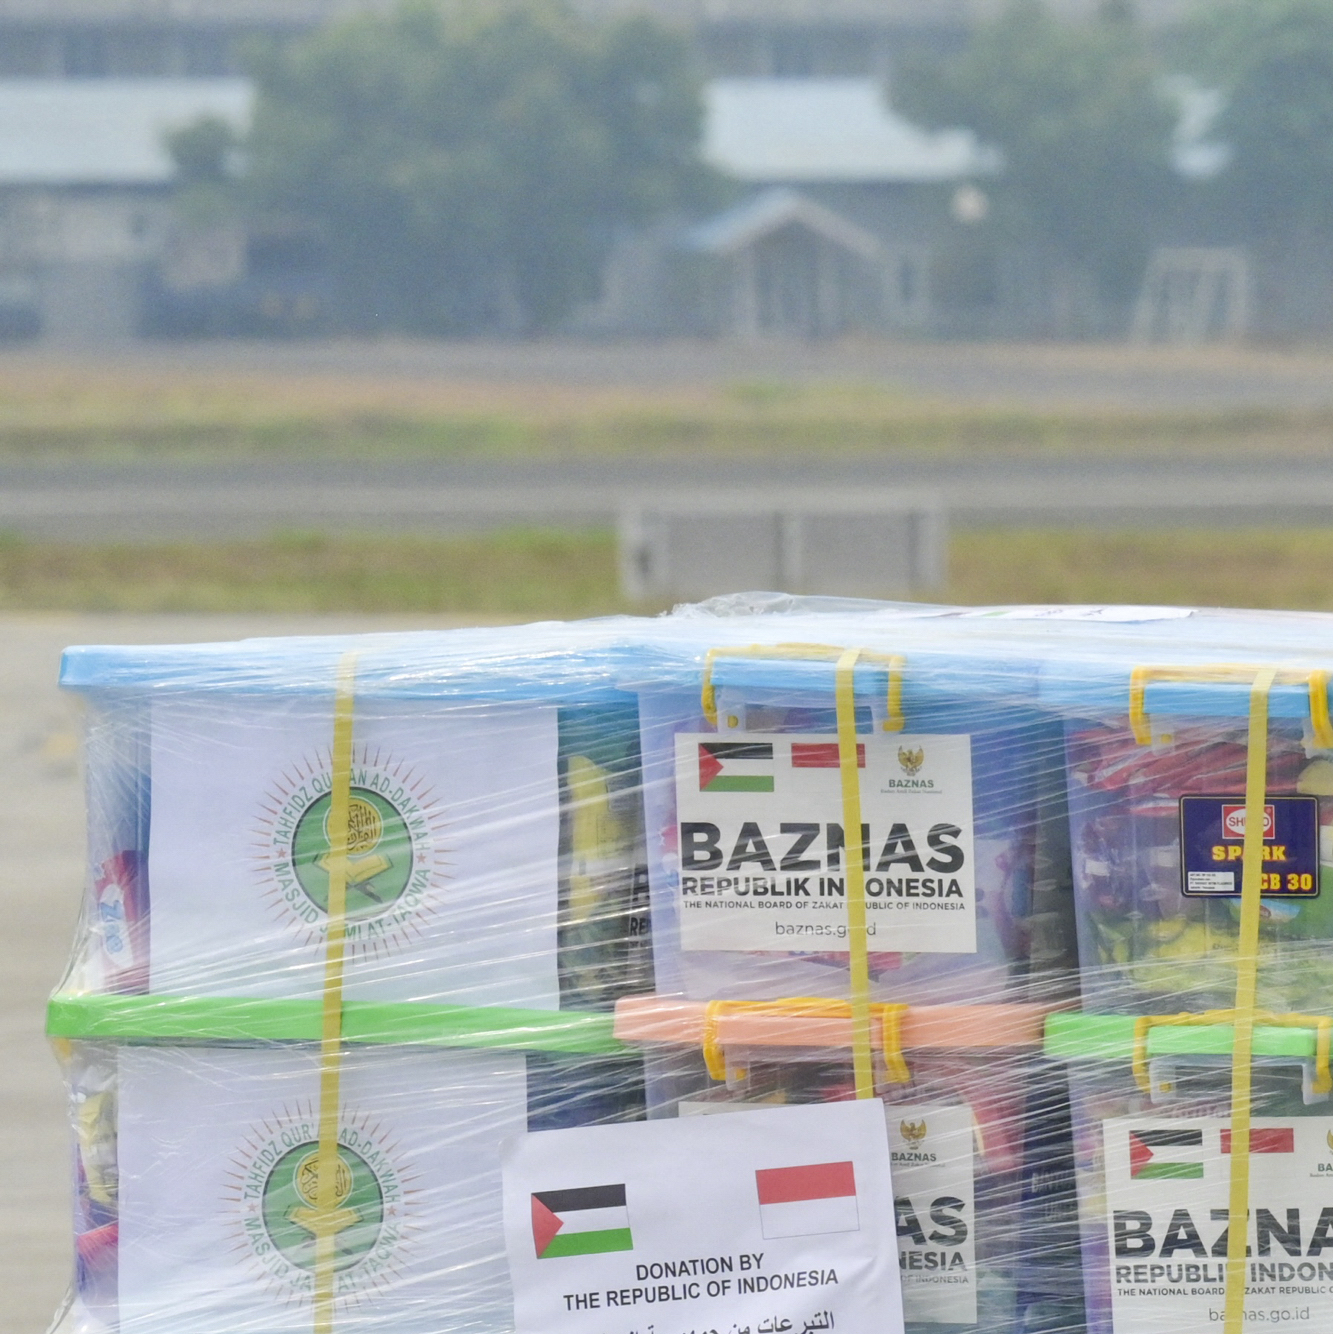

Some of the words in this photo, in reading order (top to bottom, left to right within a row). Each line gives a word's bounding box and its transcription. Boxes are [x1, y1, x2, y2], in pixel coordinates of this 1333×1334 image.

[889, 779, 934, 788] BAZNAS
[273, 786, 314, 846] TAHFIDZ
[681, 822, 965, 873] BAZNAS
[1212, 846, 1286, 861] SPRK
[274, 862, 318, 924] MASJID
[682, 877, 809, 896] REPUBLIK
[819, 878, 963, 898] INONESIA
[1288, 874, 1312, 890] 30
[244, 1140, 282, 1200] TAHFIDZ
[636, 1255, 734, 1282] DONATION
[740, 1253, 765, 1271] BY
[1116, 1264, 1224, 1284] REPUBLI
[563, 1293, 601, 1312] THE
[606, 1282, 701, 1308] REPUBLIC
[706, 1279, 733, 1298] OF
[738, 1269, 838, 1295] INDONESIA
[1209, 1307, 1310, 1323] banas.go.id
